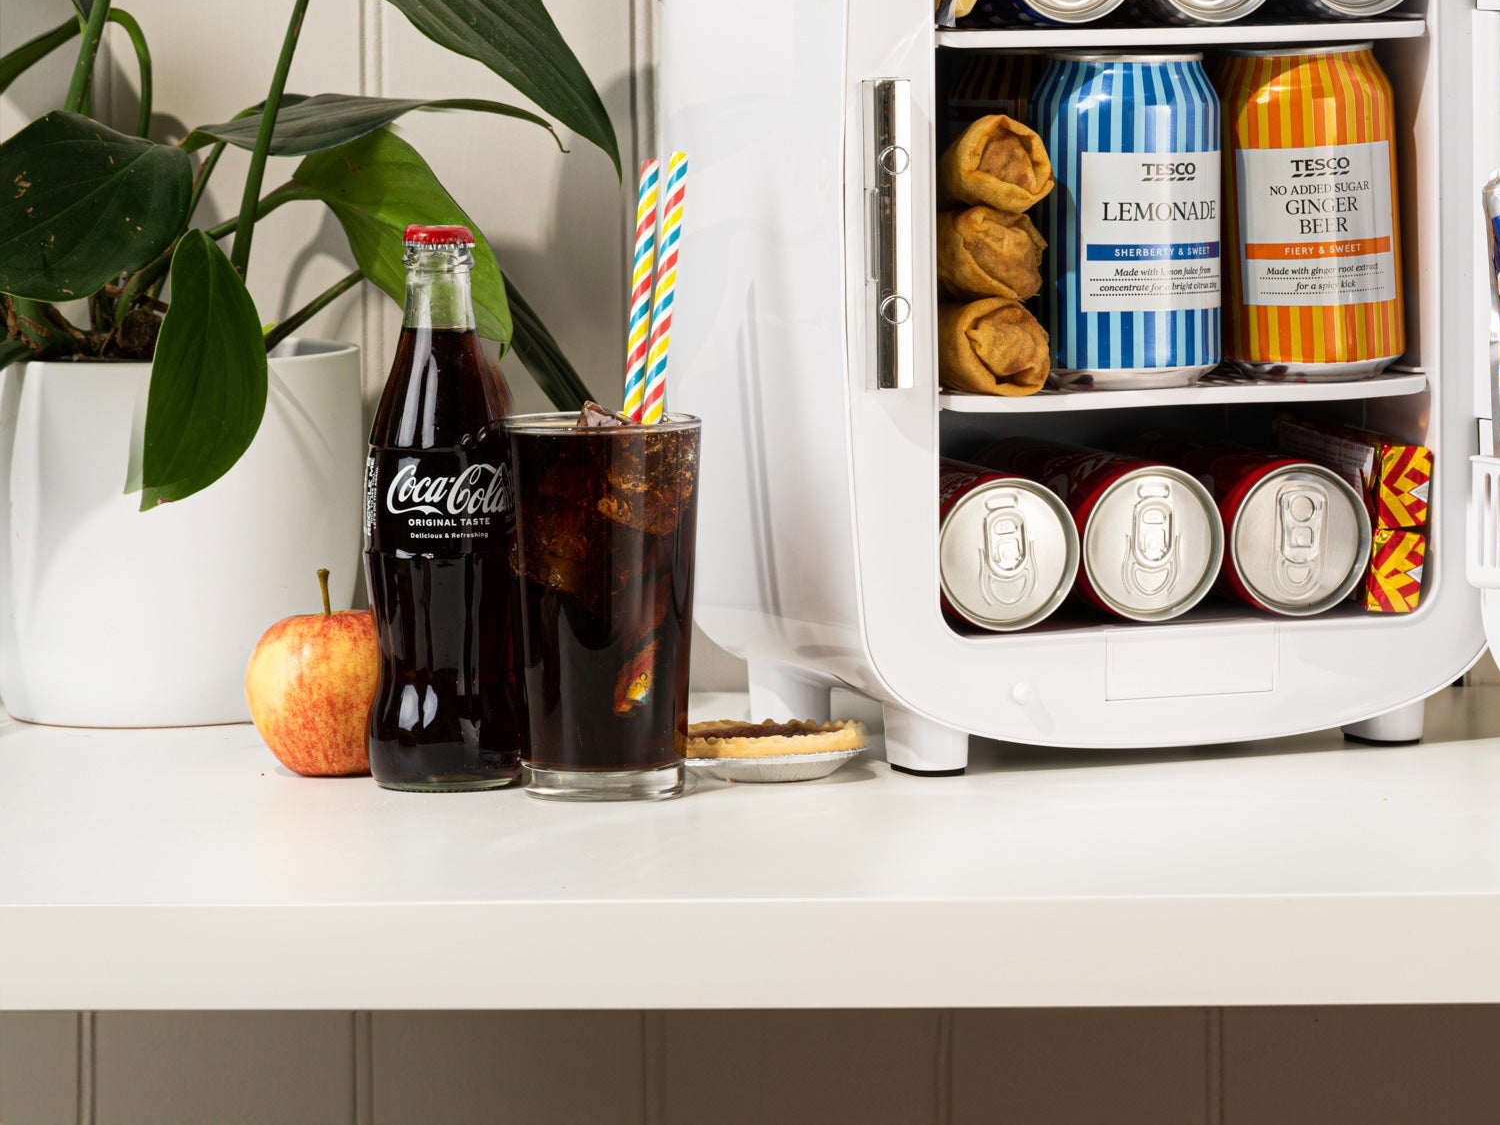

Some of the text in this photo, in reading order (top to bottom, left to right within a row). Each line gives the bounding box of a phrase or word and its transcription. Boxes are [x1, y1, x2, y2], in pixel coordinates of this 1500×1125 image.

[1142, 162, 1196, 176] TESCO
[1290, 156, 1350, 172] TESCO
[1269, 180, 1370, 196] NO ADDED SUGAR
[1102, 200, 1216, 222] LEMONADE
[1285, 196, 1359, 216] GINGER
[1299, 216, 1349, 235] BEER
[1114, 246, 1210, 257] SHERBERTY & SWEET
[1284, 243, 1362, 256] FIERY & SWEET
[1114, 267, 1139, 277] Made
[1140, 267, 1159, 276] with
[1266, 266, 1289, 276] Made
[1291, 266, 1309, 275] with
[1311, 266, 1336, 277] ginger
[1338, 264, 1354, 273] root
[1099, 283, 1150, 292] concentrate
[1150, 282, 1163, 293] for
[1171, 281, 1193, 292] bright
[1295, 281, 1309, 292] for
[1318, 281, 1339, 291] spicy
[1340, 279, 1357, 288] kick
[386, 462, 505, 515] Coca-Cola
[408, 517, 491, 527] ORIGINAL TASTE
[451, 531, 489, 539] Refreshing
